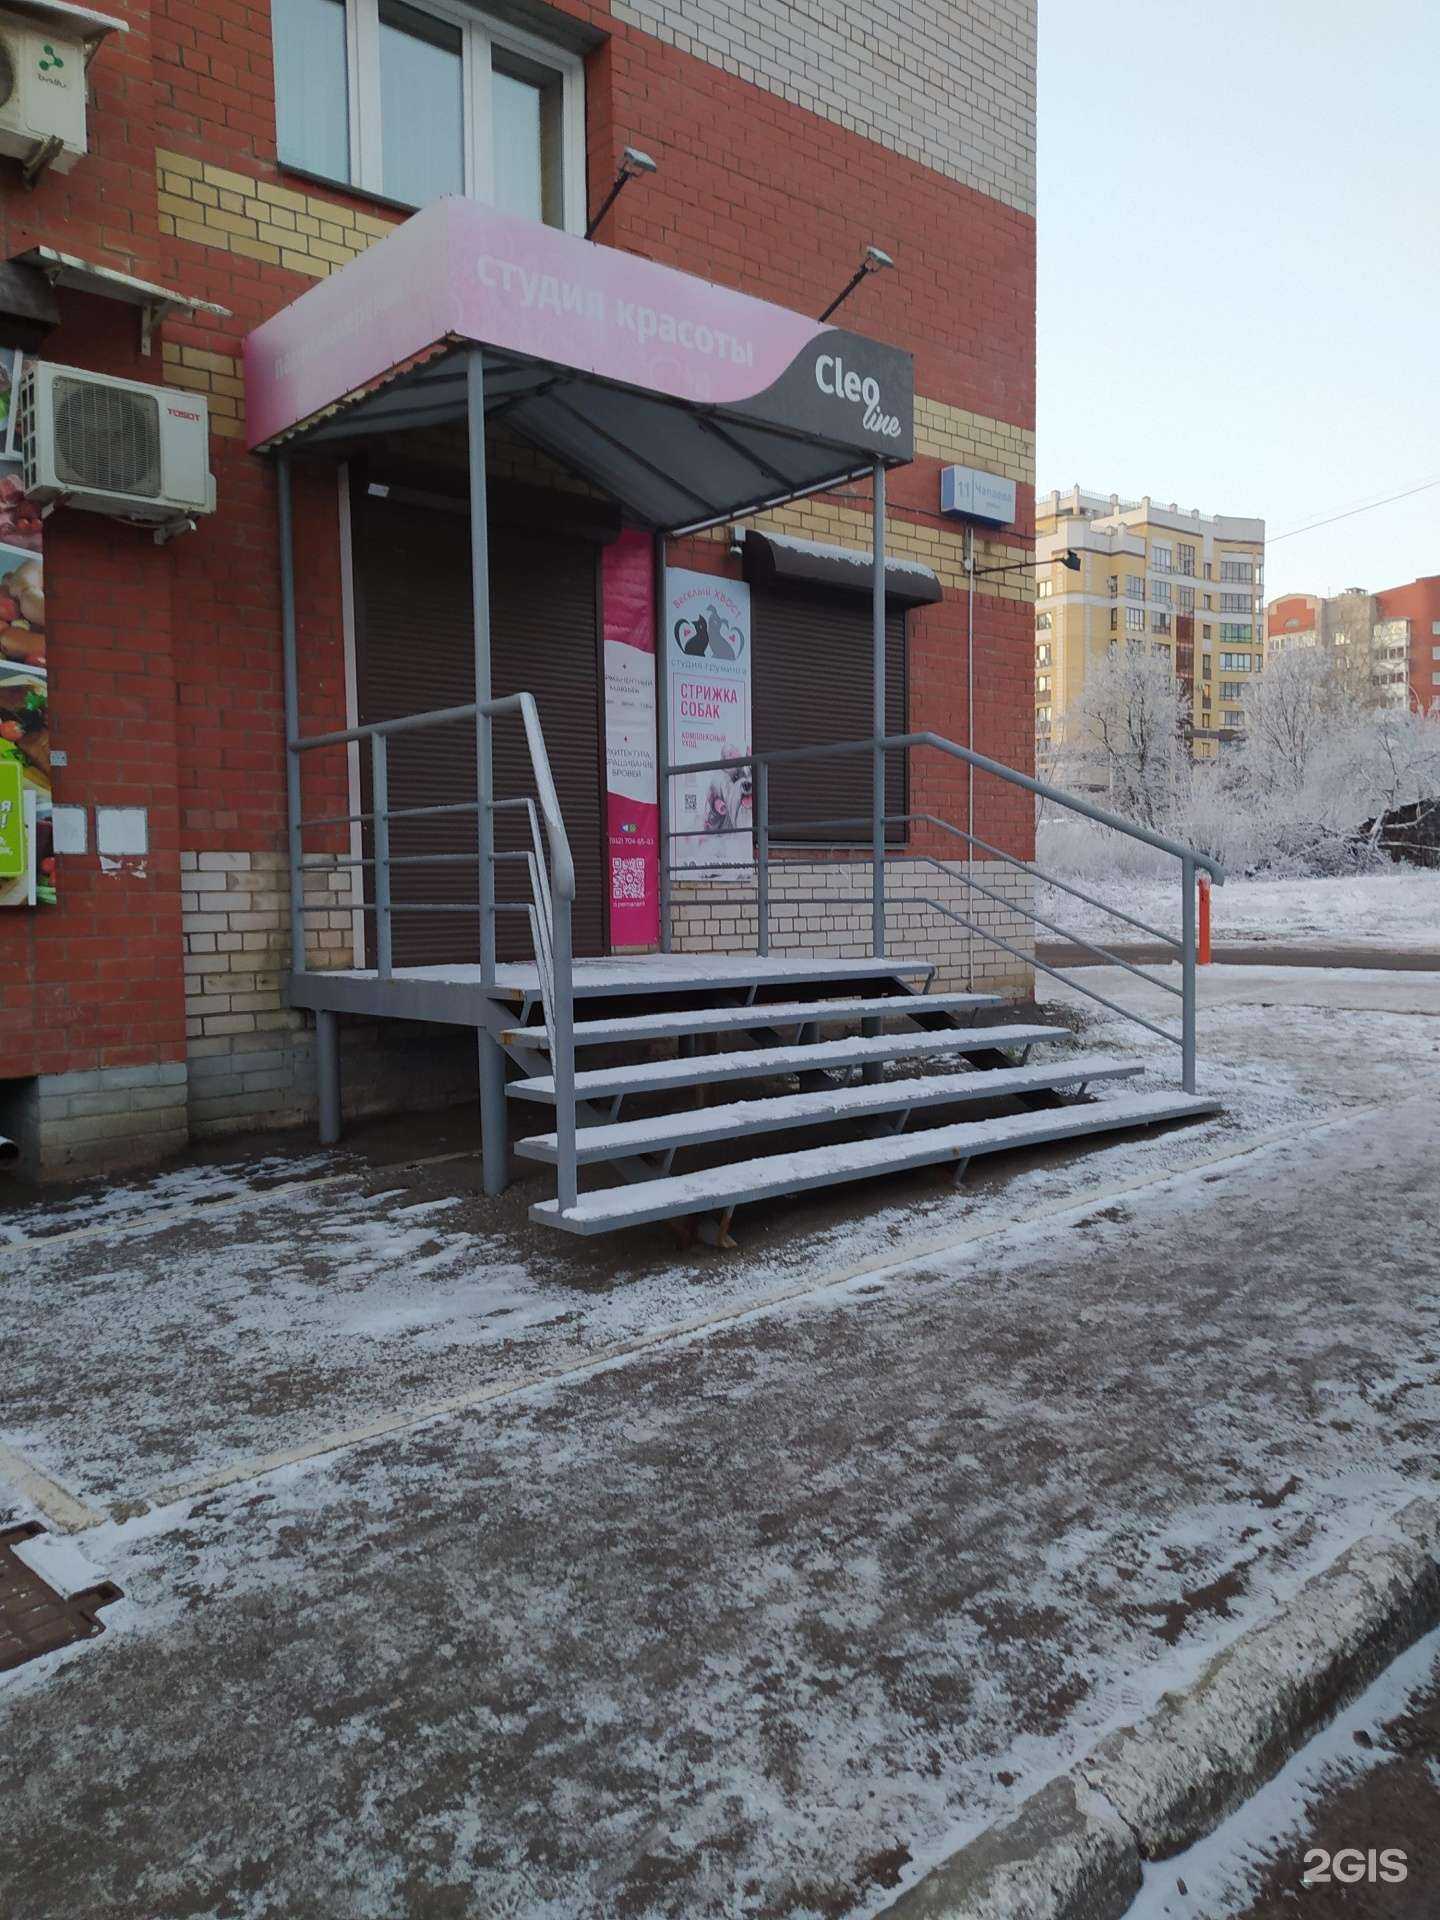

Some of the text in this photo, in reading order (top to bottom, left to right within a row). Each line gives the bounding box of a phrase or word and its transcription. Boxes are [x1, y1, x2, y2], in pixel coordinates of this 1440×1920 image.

[476, 253, 754, 367] студия красоты
[815, 354, 880, 405] Cleo
[680, 683, 738, 704] СТРИЖКА
[680, 701, 720, 719] СОБАК
